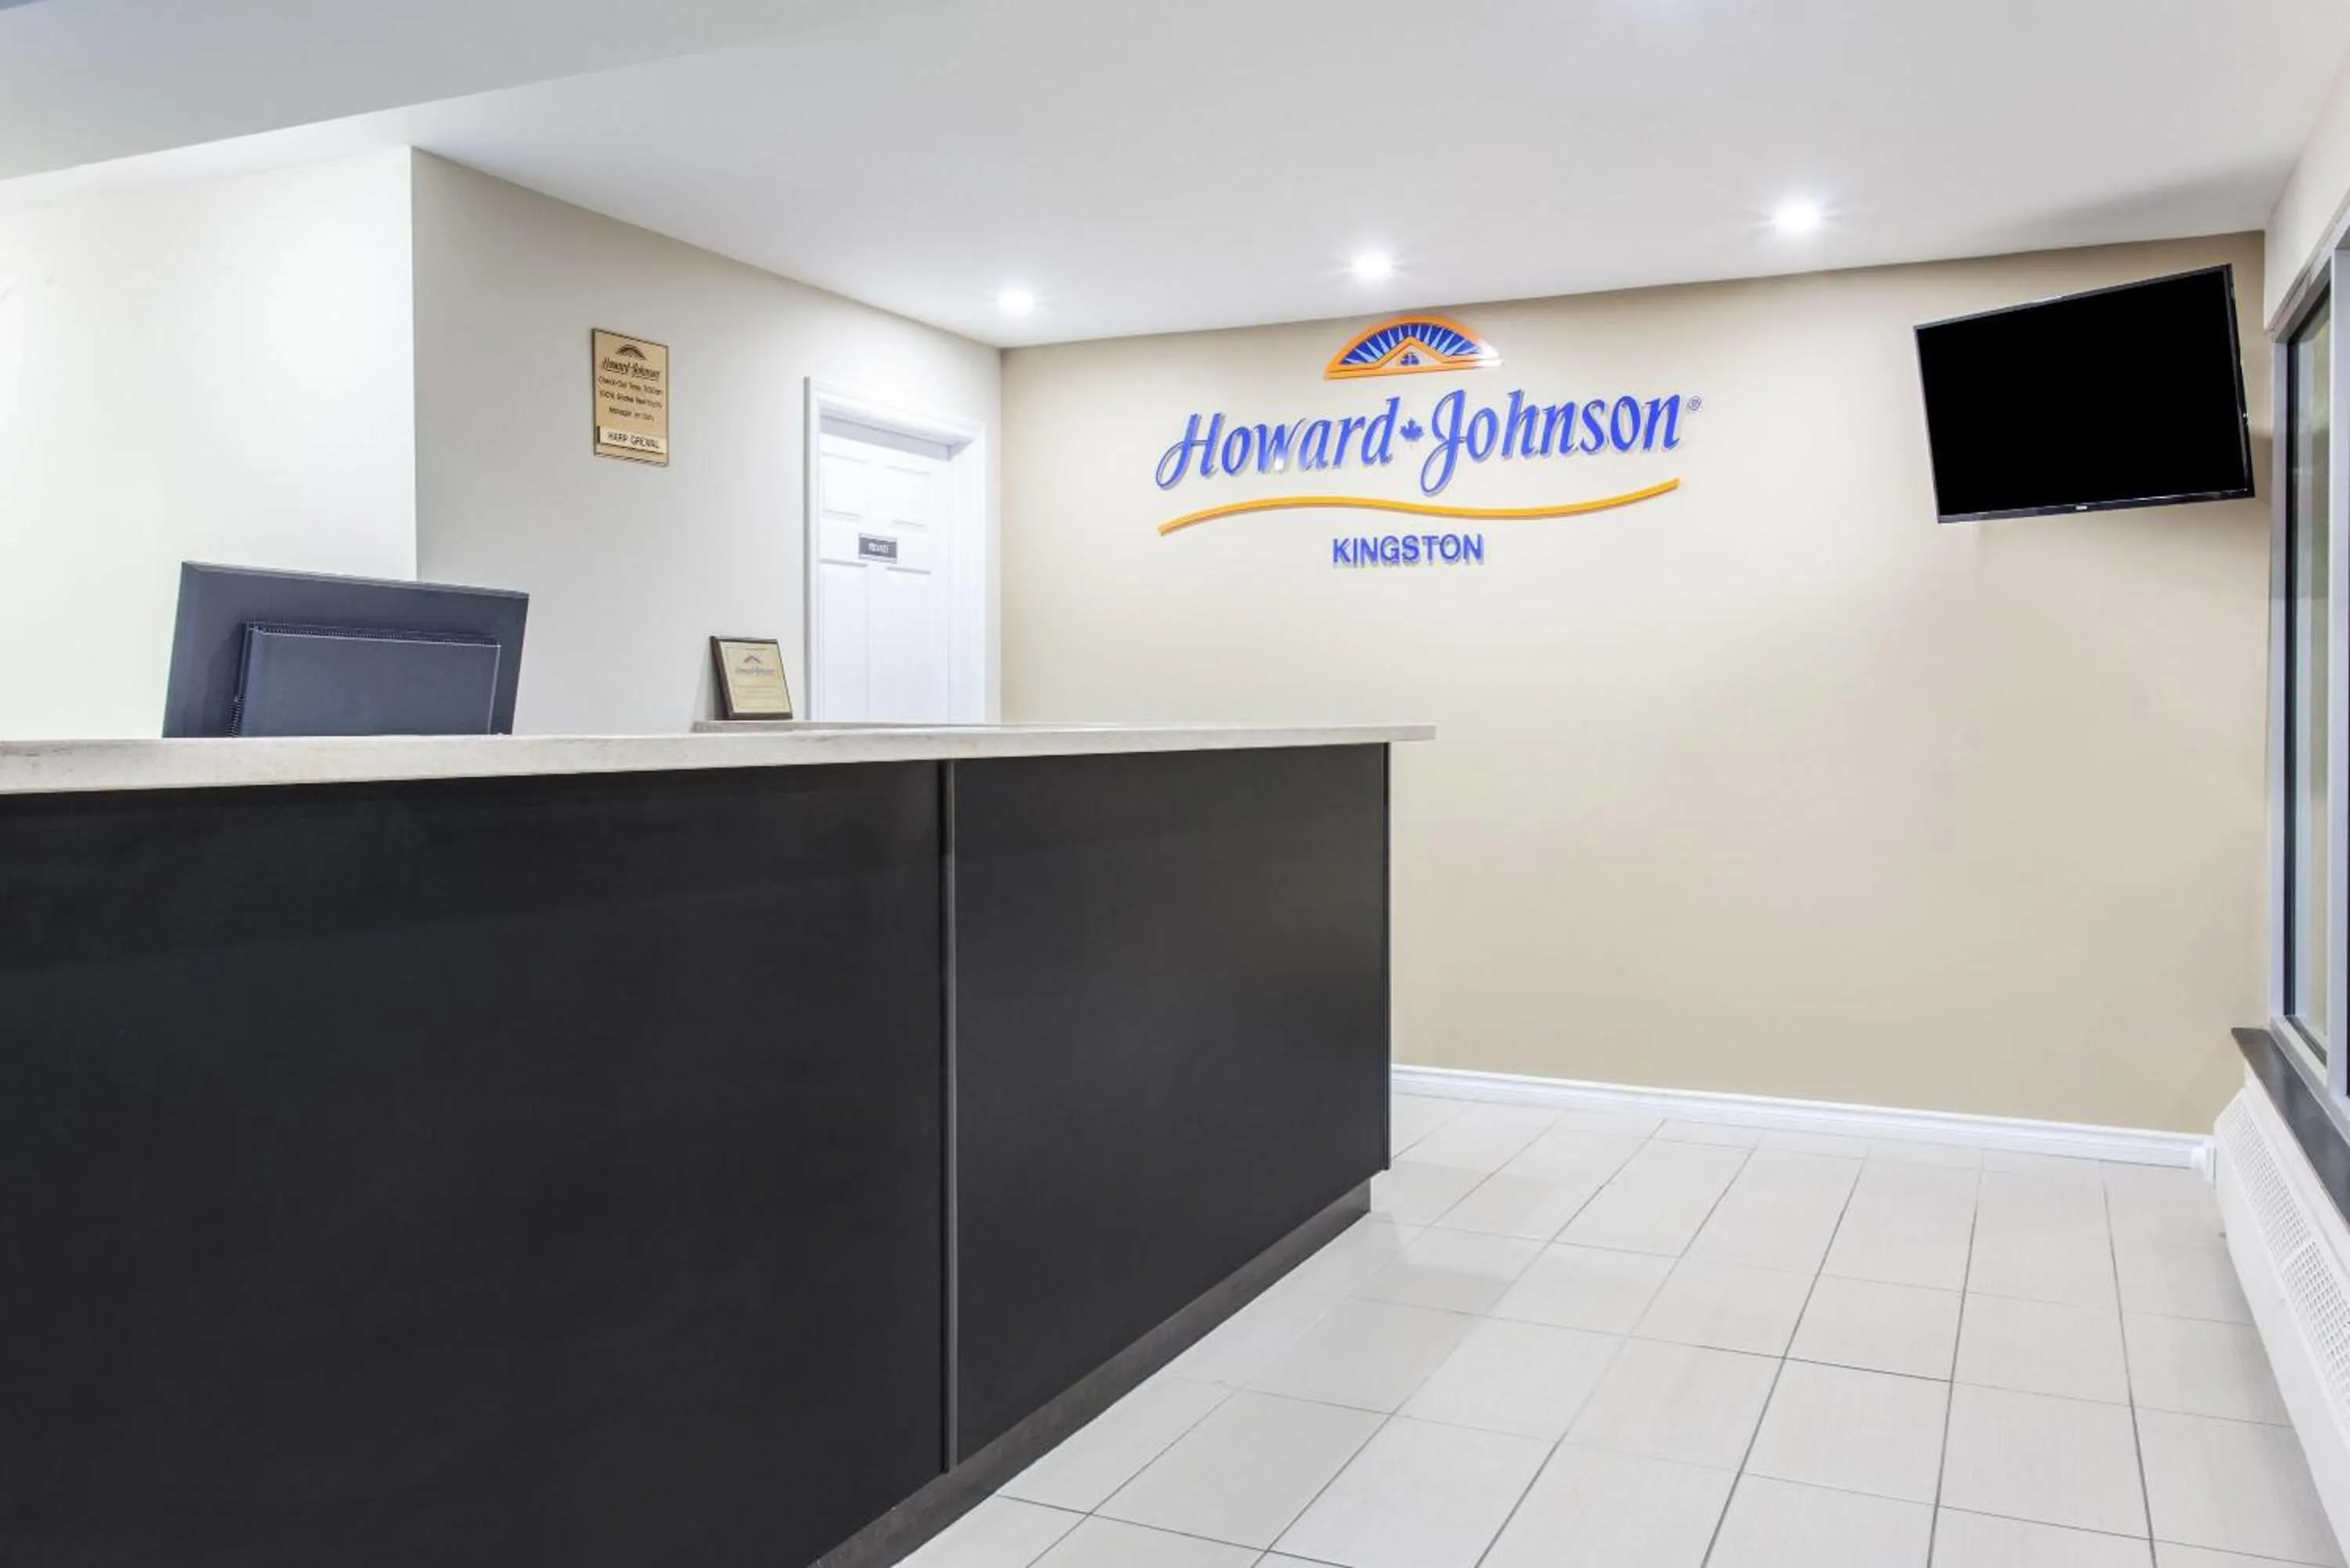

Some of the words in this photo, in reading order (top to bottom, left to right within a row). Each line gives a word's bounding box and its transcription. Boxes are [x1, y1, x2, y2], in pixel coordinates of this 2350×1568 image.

[1155, 396, 1401, 489] Howard
[1421, 388, 1681, 496] Johnson
[1332, 533, 1484, 567] KINGSTON
